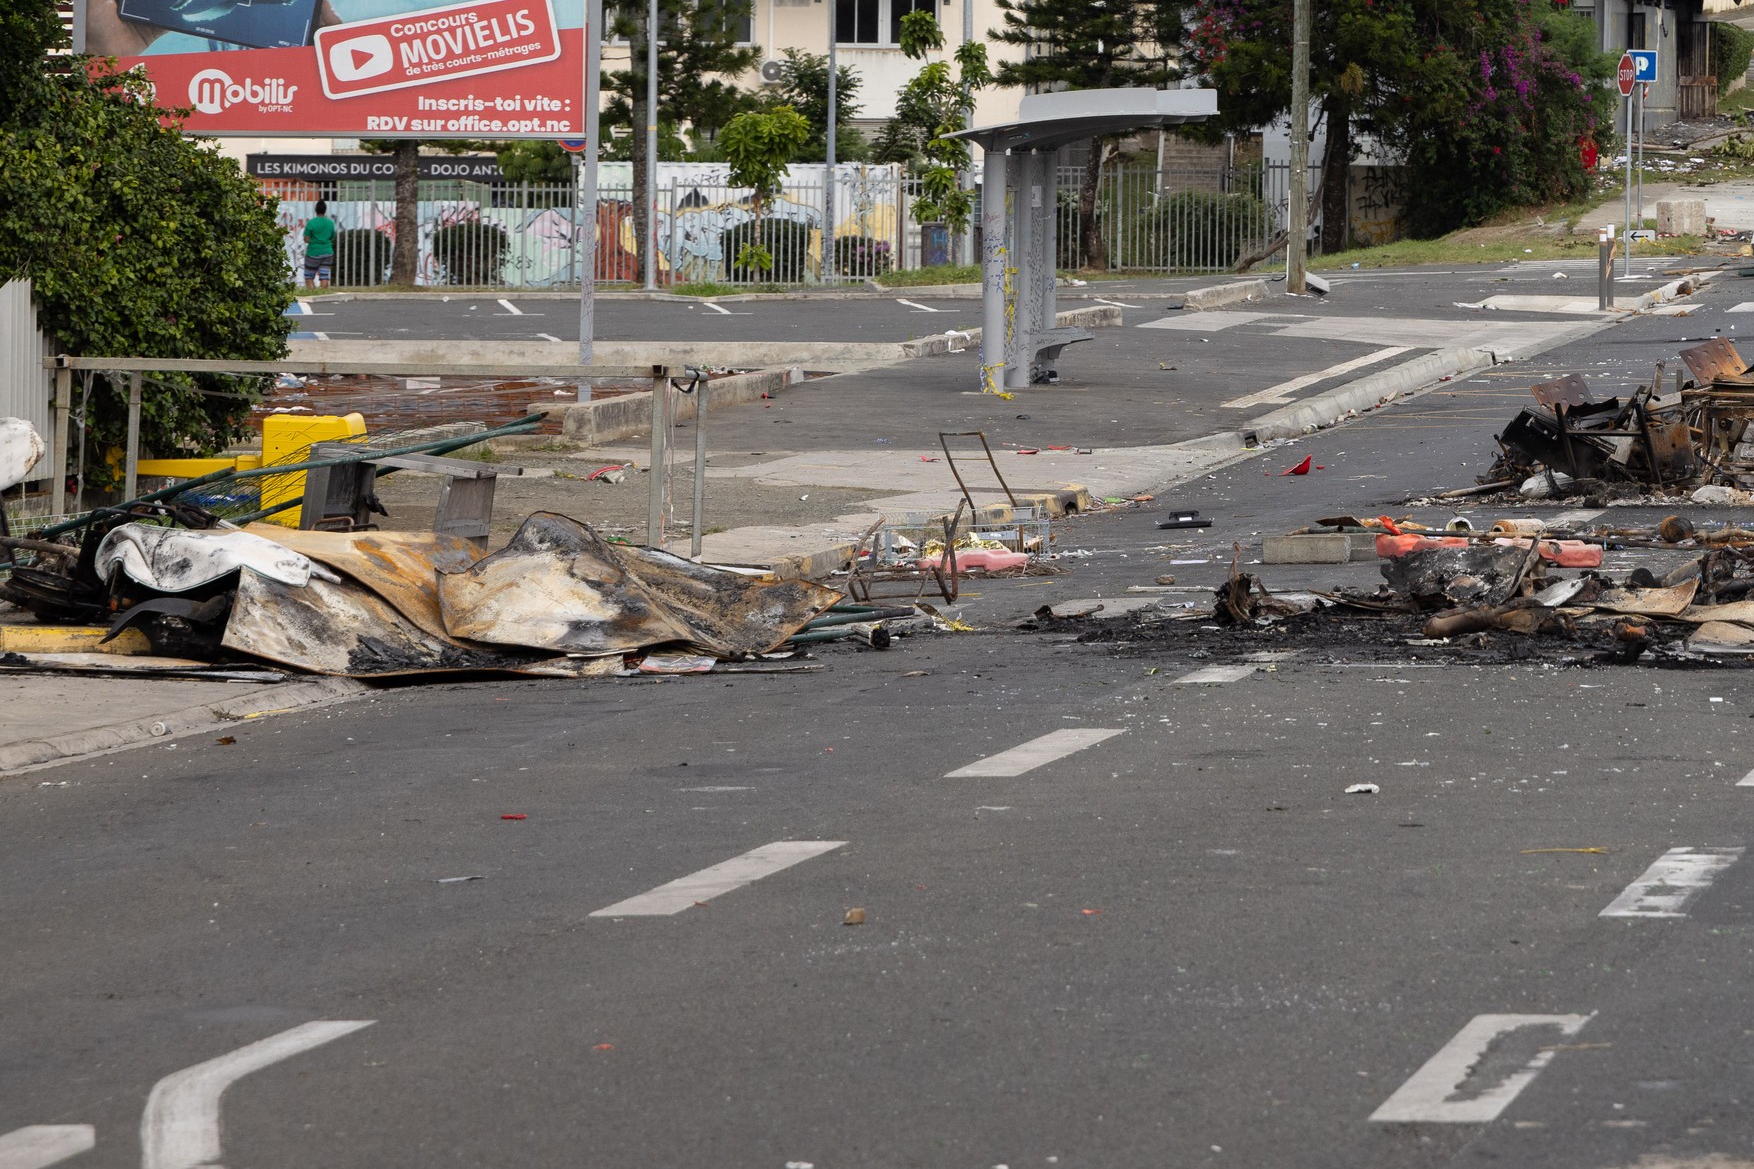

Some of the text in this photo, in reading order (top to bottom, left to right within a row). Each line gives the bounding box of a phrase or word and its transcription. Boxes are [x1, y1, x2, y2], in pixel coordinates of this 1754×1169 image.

[390, 11, 478, 38] Concours
[399, 9, 536, 69] MOVIELIS
[405, 41, 542, 76] de très courts-métrages
[1619, 69, 1633, 81] STOP
[259, 105, 293, 114] by OPT-NC
[418, 94, 521, 112] Inscris-toi
[523, 95, 562, 112] vite
[367, 115, 571, 133] RDV sur office.opt.nc
[257, 162, 281, 174] LES
[283, 162, 348, 174] KIMONOS
[350, 162, 370, 174] DU
[431, 163, 470, 176] DOJO
